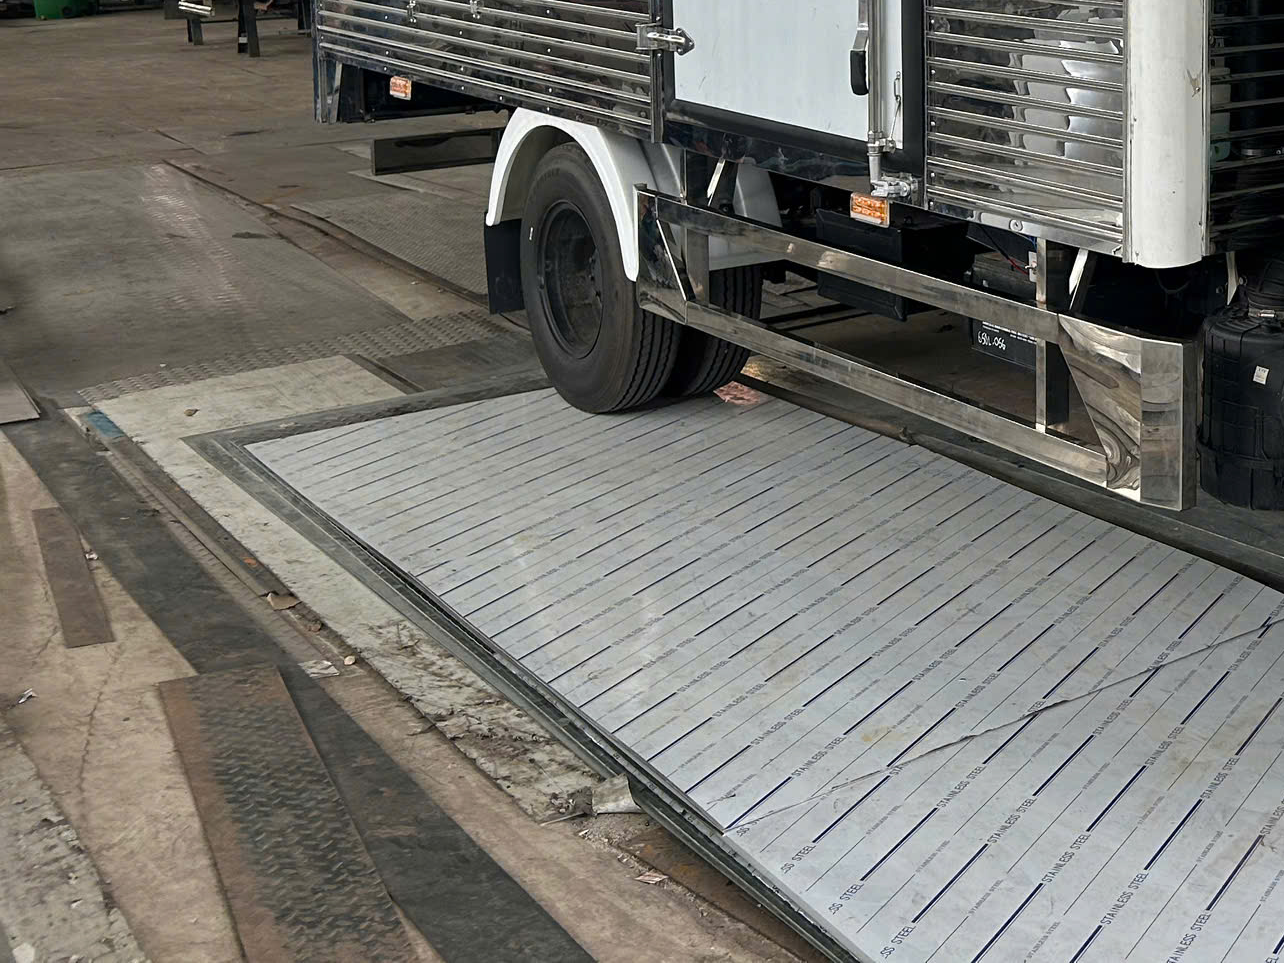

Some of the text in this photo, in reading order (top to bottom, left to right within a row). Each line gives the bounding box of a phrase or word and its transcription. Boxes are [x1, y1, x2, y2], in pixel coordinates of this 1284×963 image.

[712, 683, 766, 717] STAINLESS STEEL
[750, 708, 804, 745] STAINLESS STEEL
[1144, 723, 1185, 765] STAINLESS STEEL
[791, 737, 846, 776] STAINLESS STEEL
[936, 766, 986, 807] STAINLESS STEEL
[1200, 754, 1240, 801] STAINLESS STEEL
[987, 795, 1036, 843] STAINLESS STEEL
[791, 842, 816, 861] STEEL
[1041, 834, 1091, 885] STAINLESS STEEL
[839, 880, 864, 900] STEEL
[1100, 873, 1148, 924] STAINLESS STEEL
[890, 926, 916, 944] STEEL
[1166, 914, 1211, 963] TAINLESS STEEL
